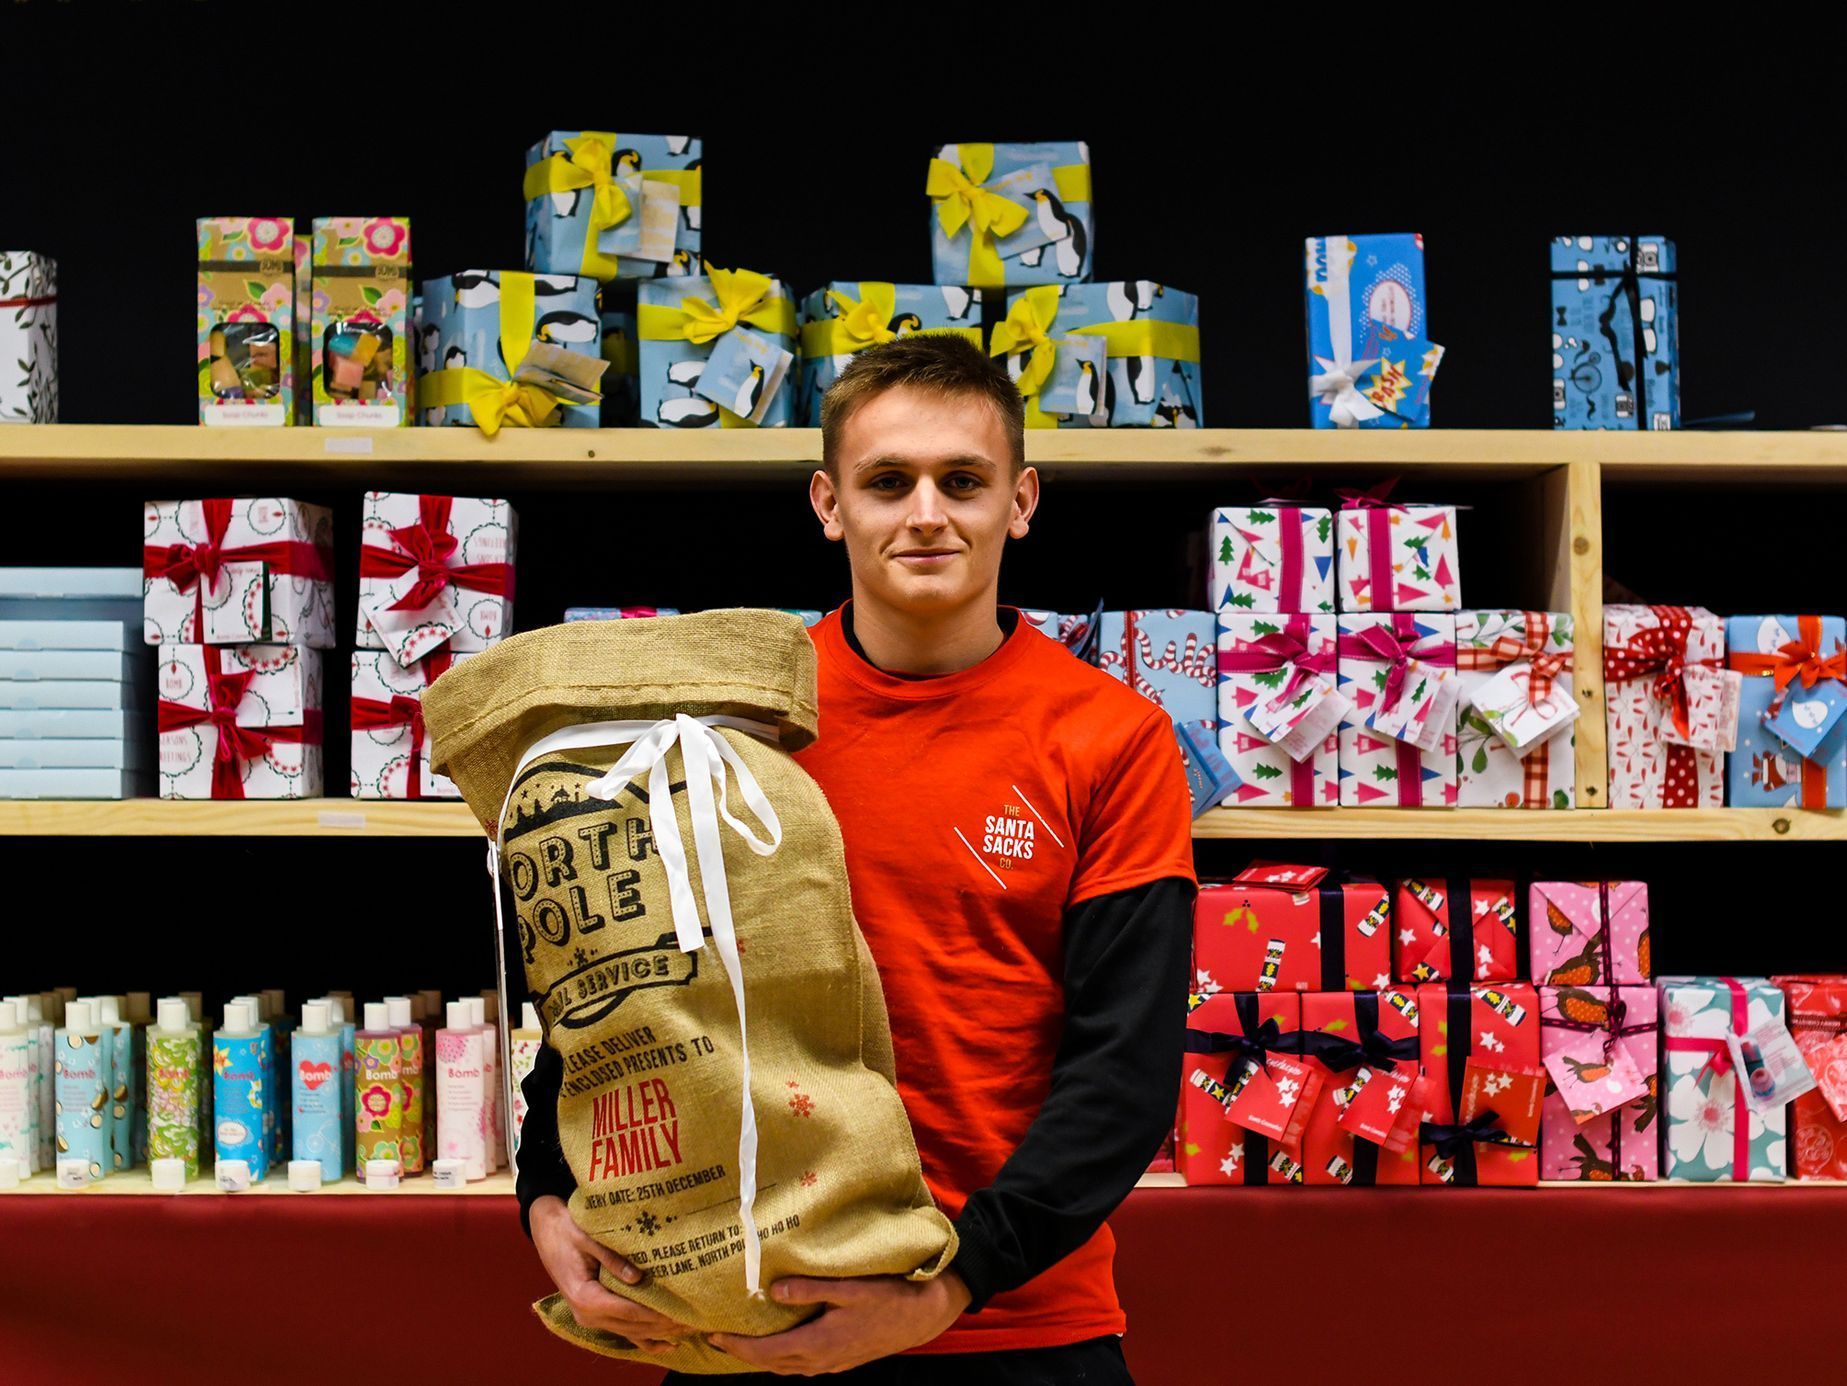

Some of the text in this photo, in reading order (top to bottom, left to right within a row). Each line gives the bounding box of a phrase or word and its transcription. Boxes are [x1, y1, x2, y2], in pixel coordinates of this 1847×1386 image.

[1004, 804, 1020, 816] THE
[984, 815, 1034, 839] SANTA
[510, 817, 660, 902] ORTH
[982, 834, 1035, 860] SACKS
[999, 857, 1014, 869] CO.
[578, 954, 670, 1000] SERVICE
[564, 1025, 657, 1076] LEASE DELIVER
[63, 1068, 96, 1080] Bomb
[223, 1071, 255, 1081] Bomb
[299, 1066, 333, 1082] Bomb
[365, 1069, 398, 1081] Bomb
[448, 1068, 481, 1081] Bomb
[564, 1035, 715, 1097] ENCLOSED PRESENTS TO
[591, 1076, 678, 1140] MILLER
[588, 1119, 683, 1183] FAMILY
[609, 1188, 636, 1206] DATE:
[637, 1182, 666, 1202] 25TH
[666, 1164, 727, 1195] DECEMBER
[652, 1241, 688, 1261] PLEASE
[688, 1229, 727, 1253] RETURN
[697, 1246, 730, 1267] NORTH
[771, 1220, 784, 1236] HO
[785, 1214, 801, 1230] HO
